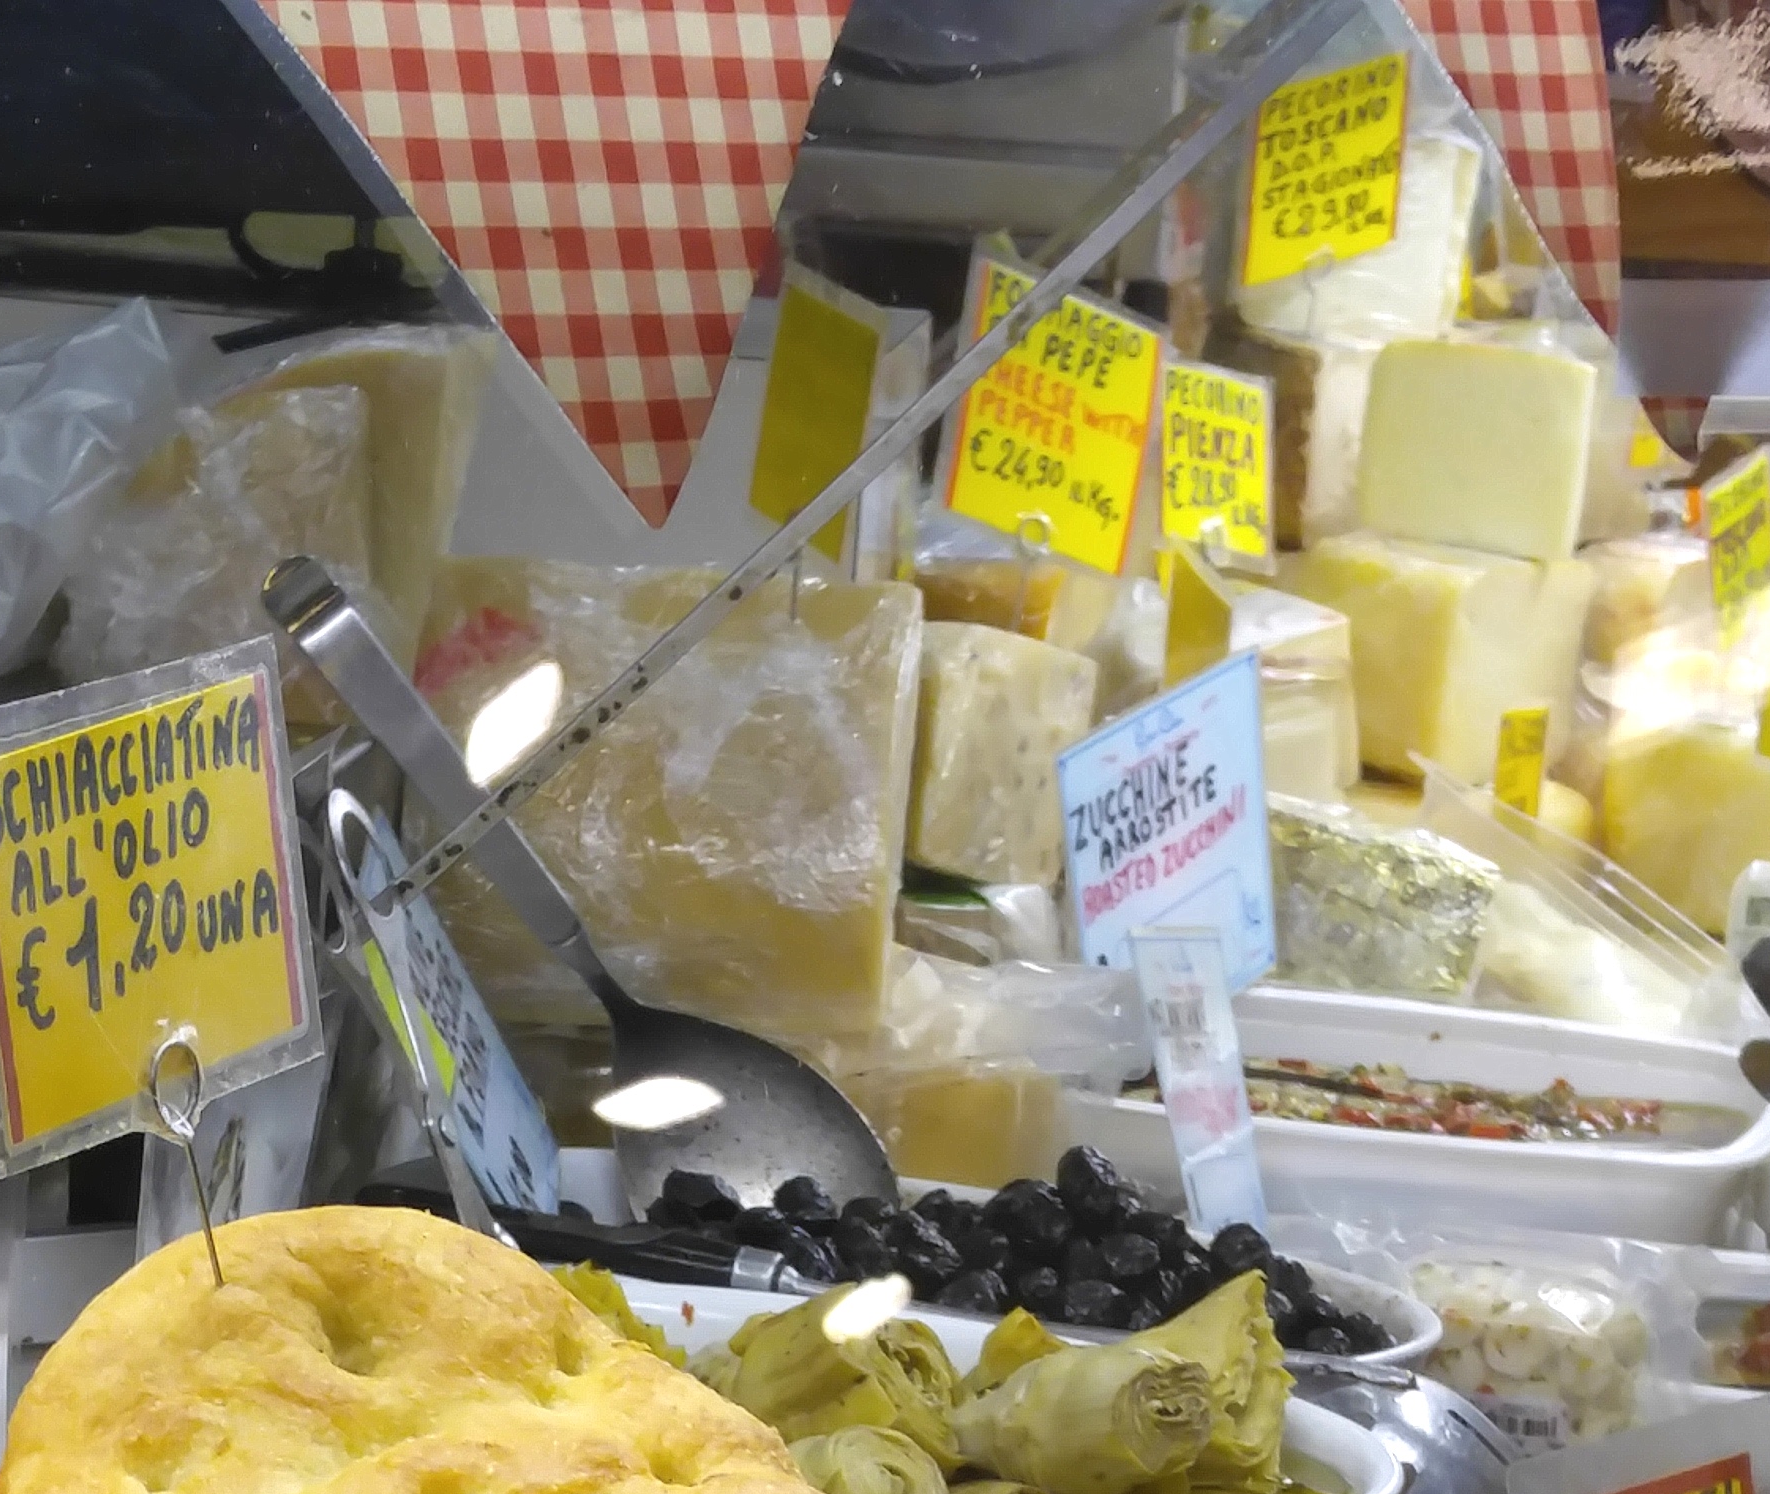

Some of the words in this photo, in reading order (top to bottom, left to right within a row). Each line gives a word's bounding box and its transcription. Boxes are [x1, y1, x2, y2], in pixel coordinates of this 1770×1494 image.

[991, 270, 1141, 358] FOAGGIO
[1042, 334, 1114, 390] PEPE
[1069, 740, 1188, 852] ZUCCHINE
[10, 787, 210, 916] ALL'OLIO
[195, 867, 280, 954] UNA
